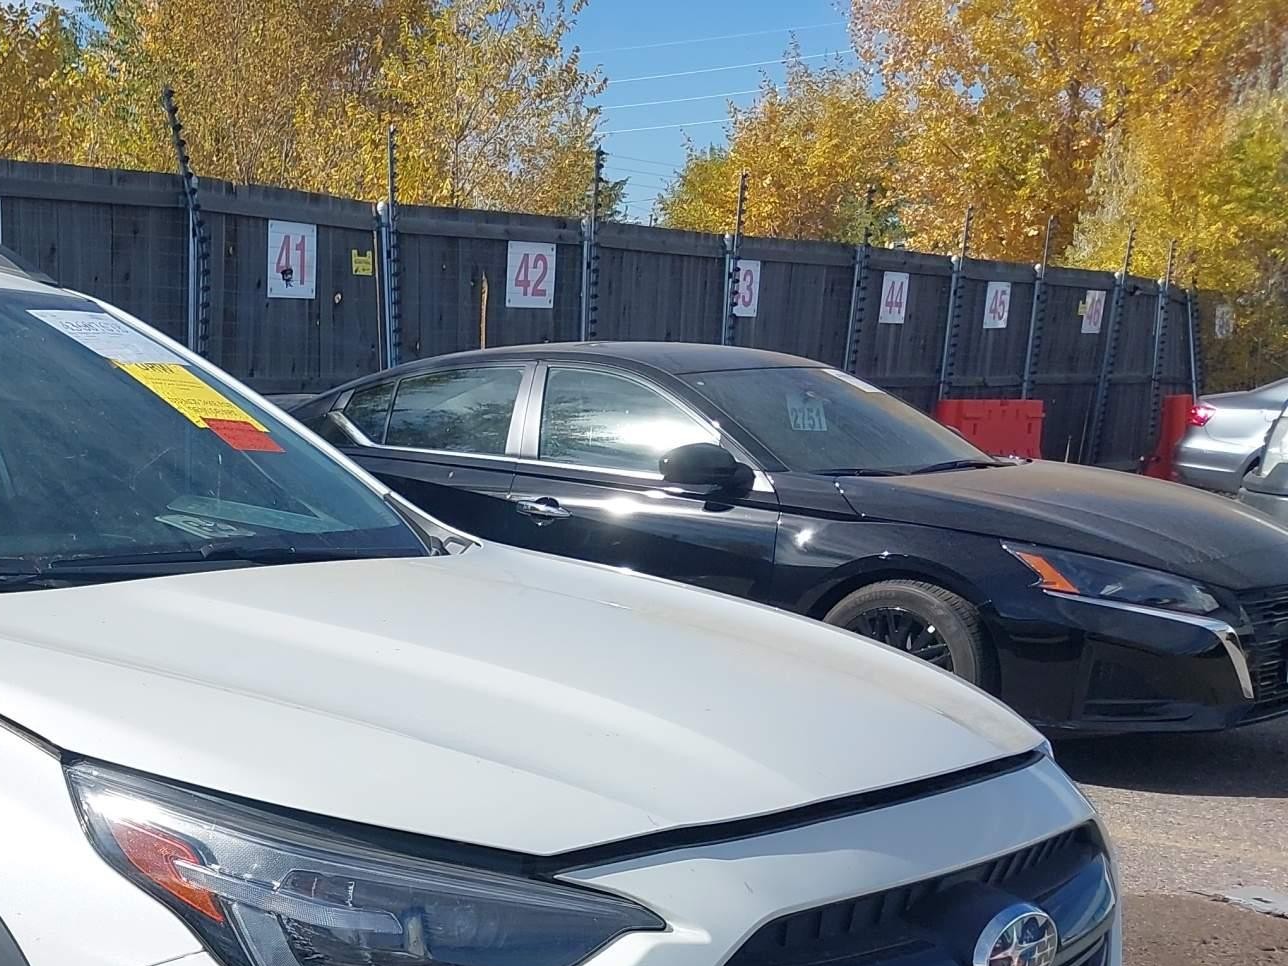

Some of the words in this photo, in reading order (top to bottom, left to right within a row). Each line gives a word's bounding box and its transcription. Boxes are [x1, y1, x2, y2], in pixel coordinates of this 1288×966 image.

[275, 234, 306, 286] 41
[514, 253, 548, 296] 42
[885, 281, 904, 314] 44
[989, 289, 1007, 321] 45
[791, 407, 824, 430] 2751
